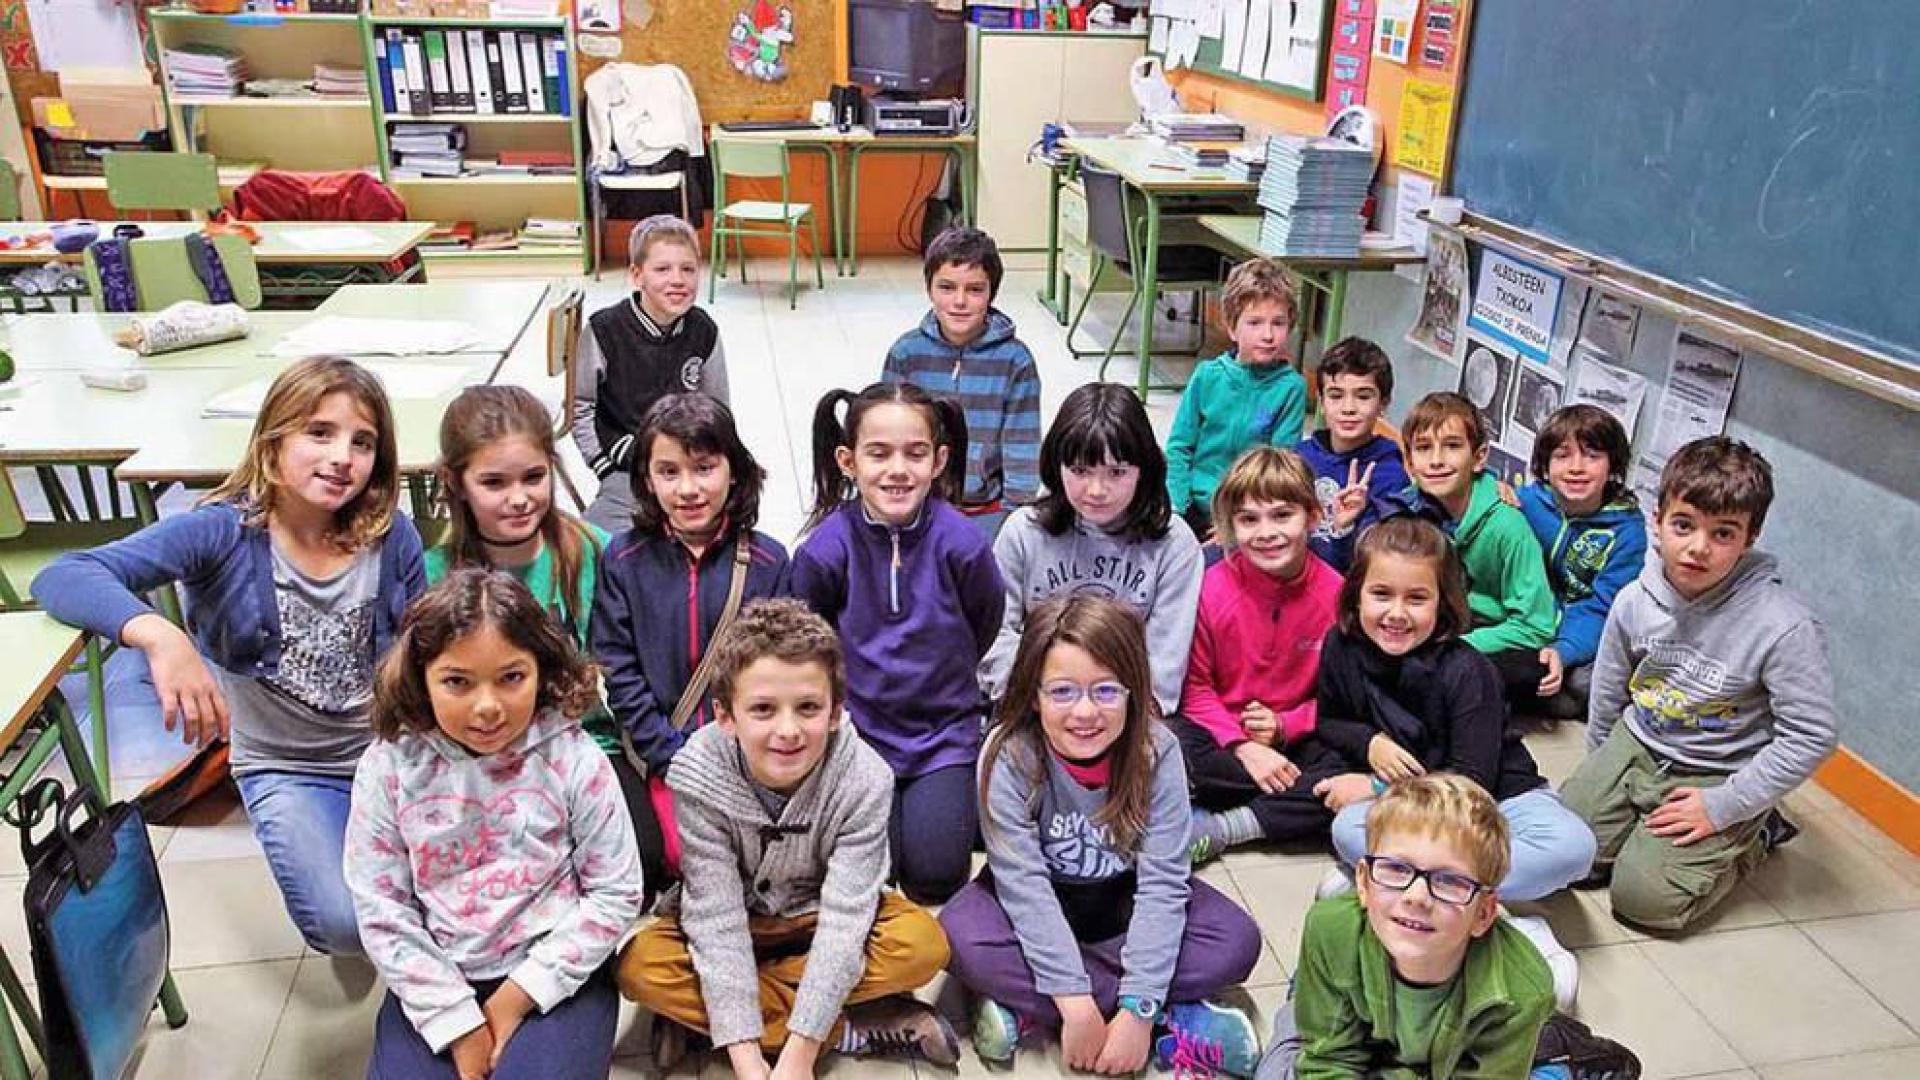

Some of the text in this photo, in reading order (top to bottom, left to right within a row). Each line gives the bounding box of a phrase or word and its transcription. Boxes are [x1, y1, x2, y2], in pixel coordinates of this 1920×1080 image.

[1492, 263, 1546, 296] ALBISTEEN
[1496, 286, 1533, 315] TXOKOA
[1047, 560, 1082, 589] ALL
